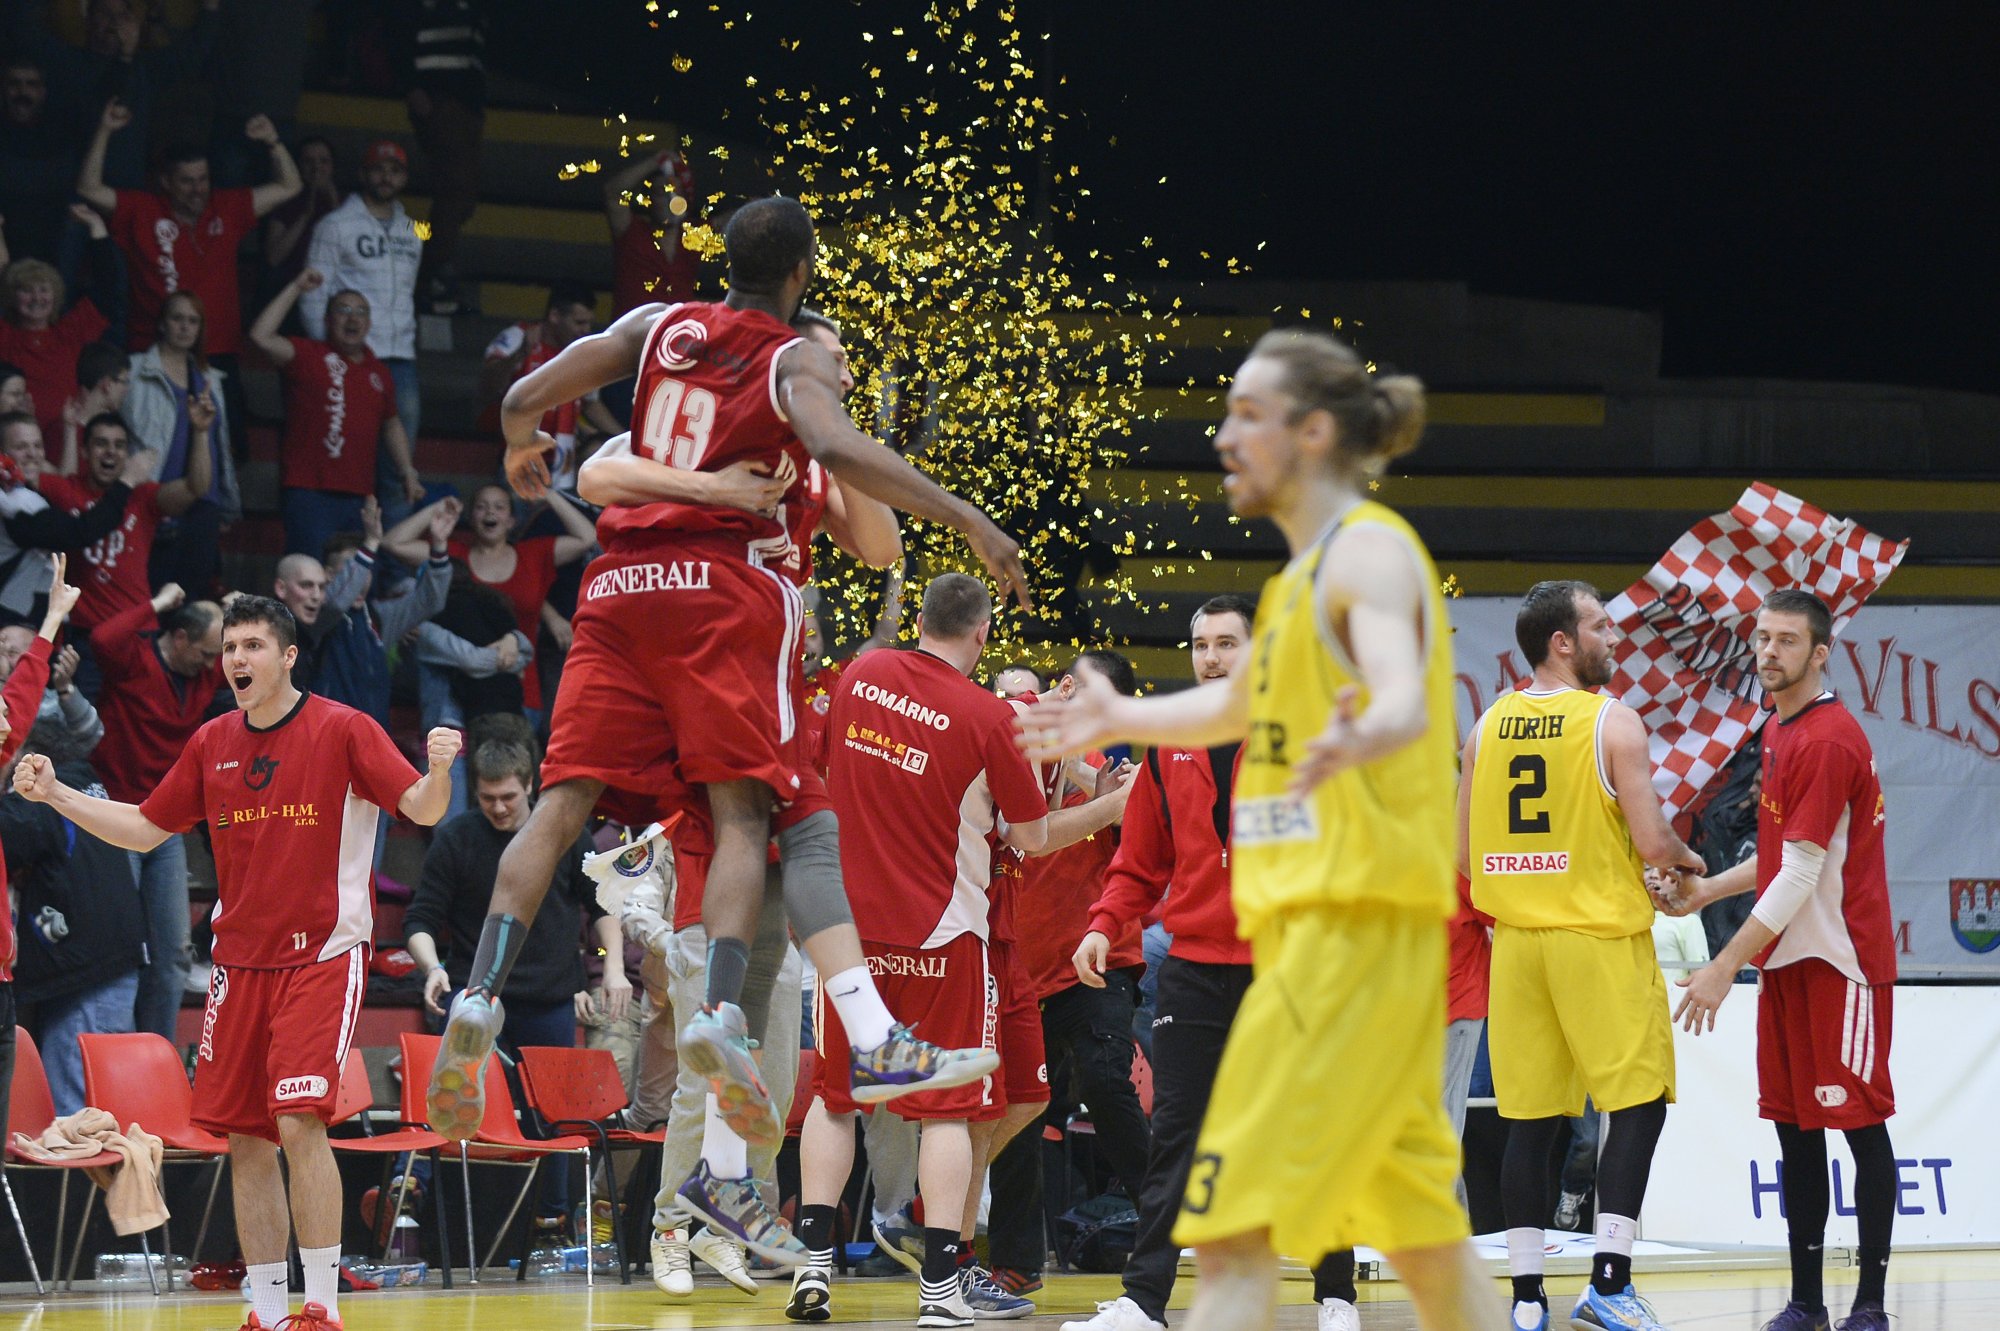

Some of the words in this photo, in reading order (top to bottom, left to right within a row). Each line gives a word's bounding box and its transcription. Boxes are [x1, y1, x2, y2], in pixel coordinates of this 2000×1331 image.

[642, 377, 716, 471] 43
[586, 560, 711, 601] GENERALI
[851, 680, 950, 731] KOMÁRNO
[1498, 714, 1565, 740] UDRIH
[222, 761, 239, 769] JAKO
[1508, 754, 1551, 834] 2
[282, 803, 318, 818] H.M.
[1485, 854, 1567, 872] STRABAG
[292, 931, 307, 950] 11
[864, 952, 948, 978] ENERALI
[279, 1080, 311, 1096] SAM
